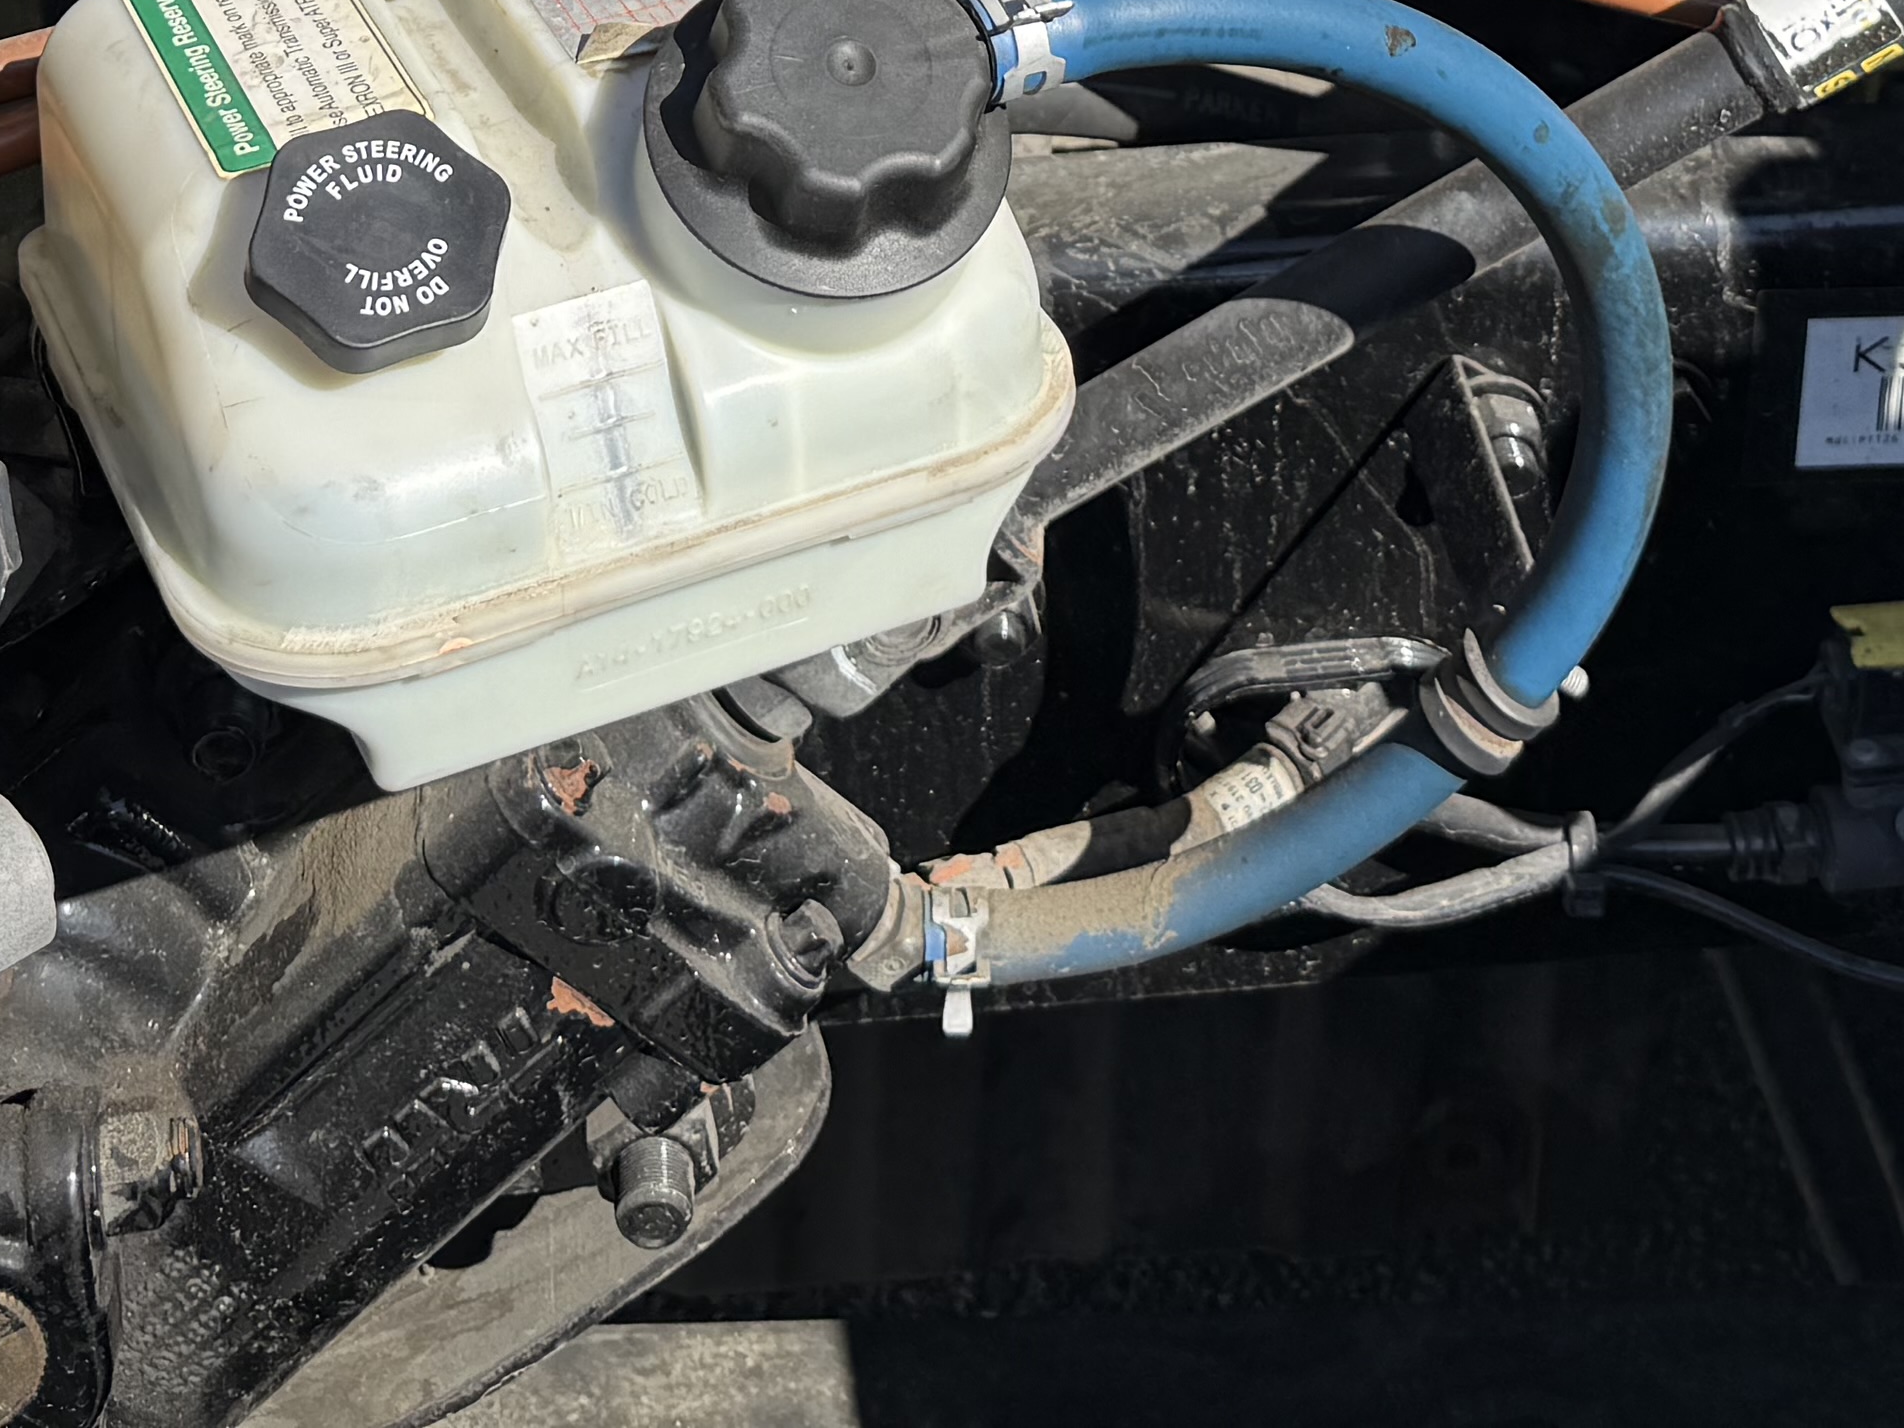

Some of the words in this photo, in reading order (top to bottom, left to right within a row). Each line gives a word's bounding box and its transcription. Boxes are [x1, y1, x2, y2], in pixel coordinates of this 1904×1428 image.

[223, 8, 241, 24] on
[230, 24, 258, 52] mark
[315, 20, 343, 50] Super
[332, 48, 348, 61] or
[185, 43, 232, 108] Steering
[249, 48, 296, 114] appropriate
[295, 55, 338, 114] Automatic
[349, 77, 386, 118] EXRON
[218, 107, 260, 156] Power
[329, 111, 348, 127] se
[284, 154, 341, 222] POWER
[342, 140, 454, 182] STEERING
[326, 164, 402, 200] FLUID
[345, 238, 448, 291] OVERFILL
[360, 295, 410, 316] NOT
[416, 276, 450, 304] DO
[532, 337, 584, 370] MAX
